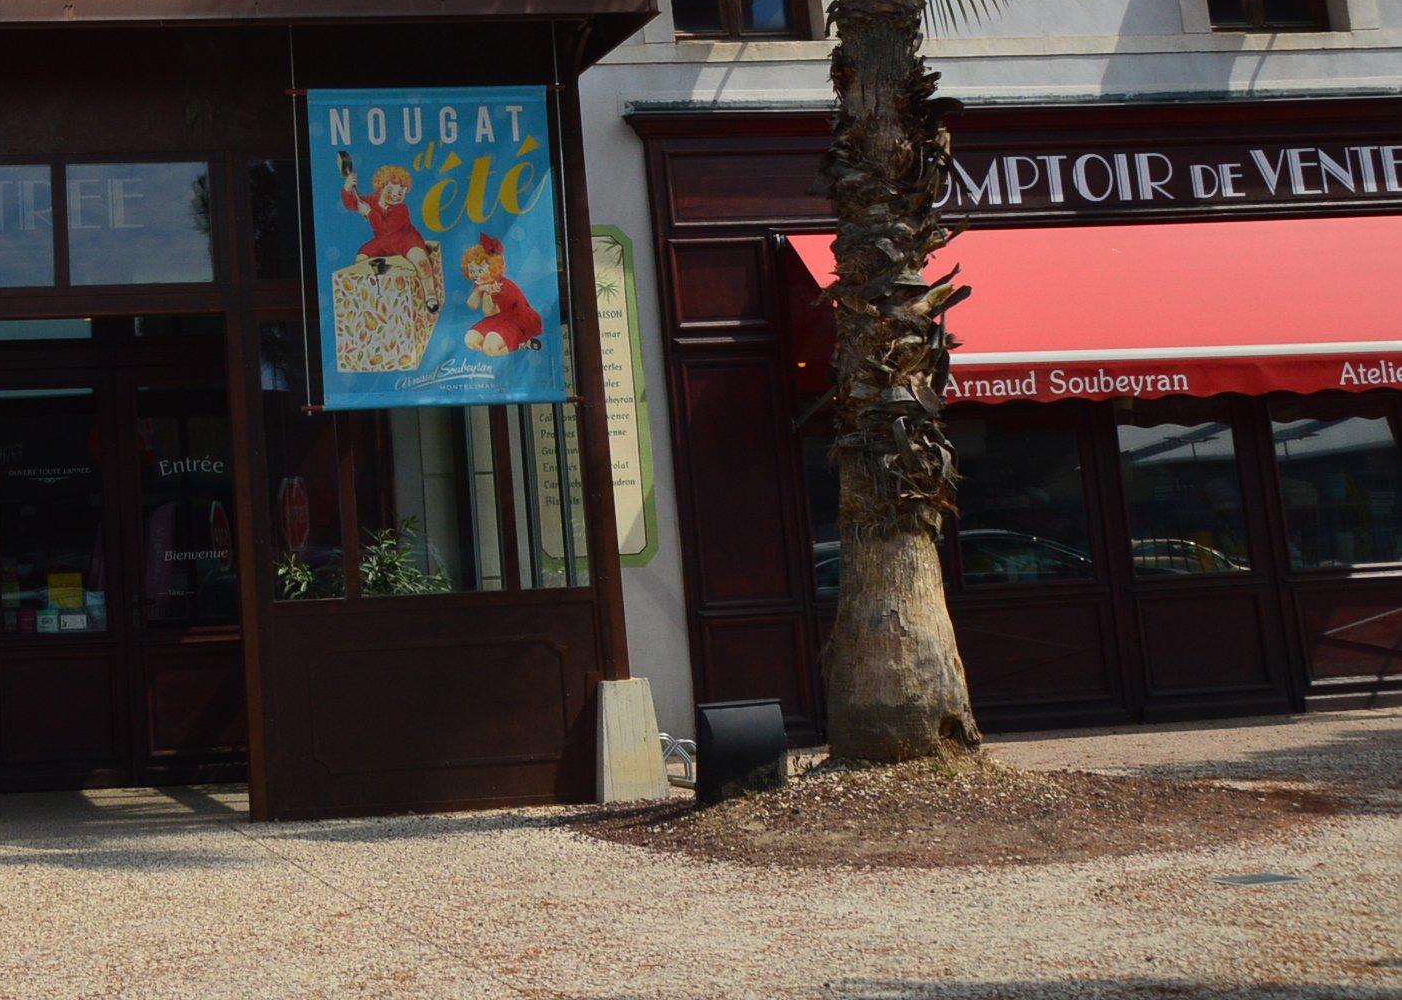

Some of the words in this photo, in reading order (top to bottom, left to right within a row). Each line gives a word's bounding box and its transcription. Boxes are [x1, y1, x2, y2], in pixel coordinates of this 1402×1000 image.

[329, 104, 524, 147] NOUGAT
[929, 152, 1174, 208] MPTOIR
[1191, 163, 1247, 198] DE
[1250, 145, 1402, 195] VENTE
[598, 310, 623, 319] AISON
[942, 369, 1038, 398] Arnaud
[1049, 367, 1190, 399] Soubeyran
[159, 454, 225, 477] Entrée
[164, 549, 229, 562] Bienvenue
